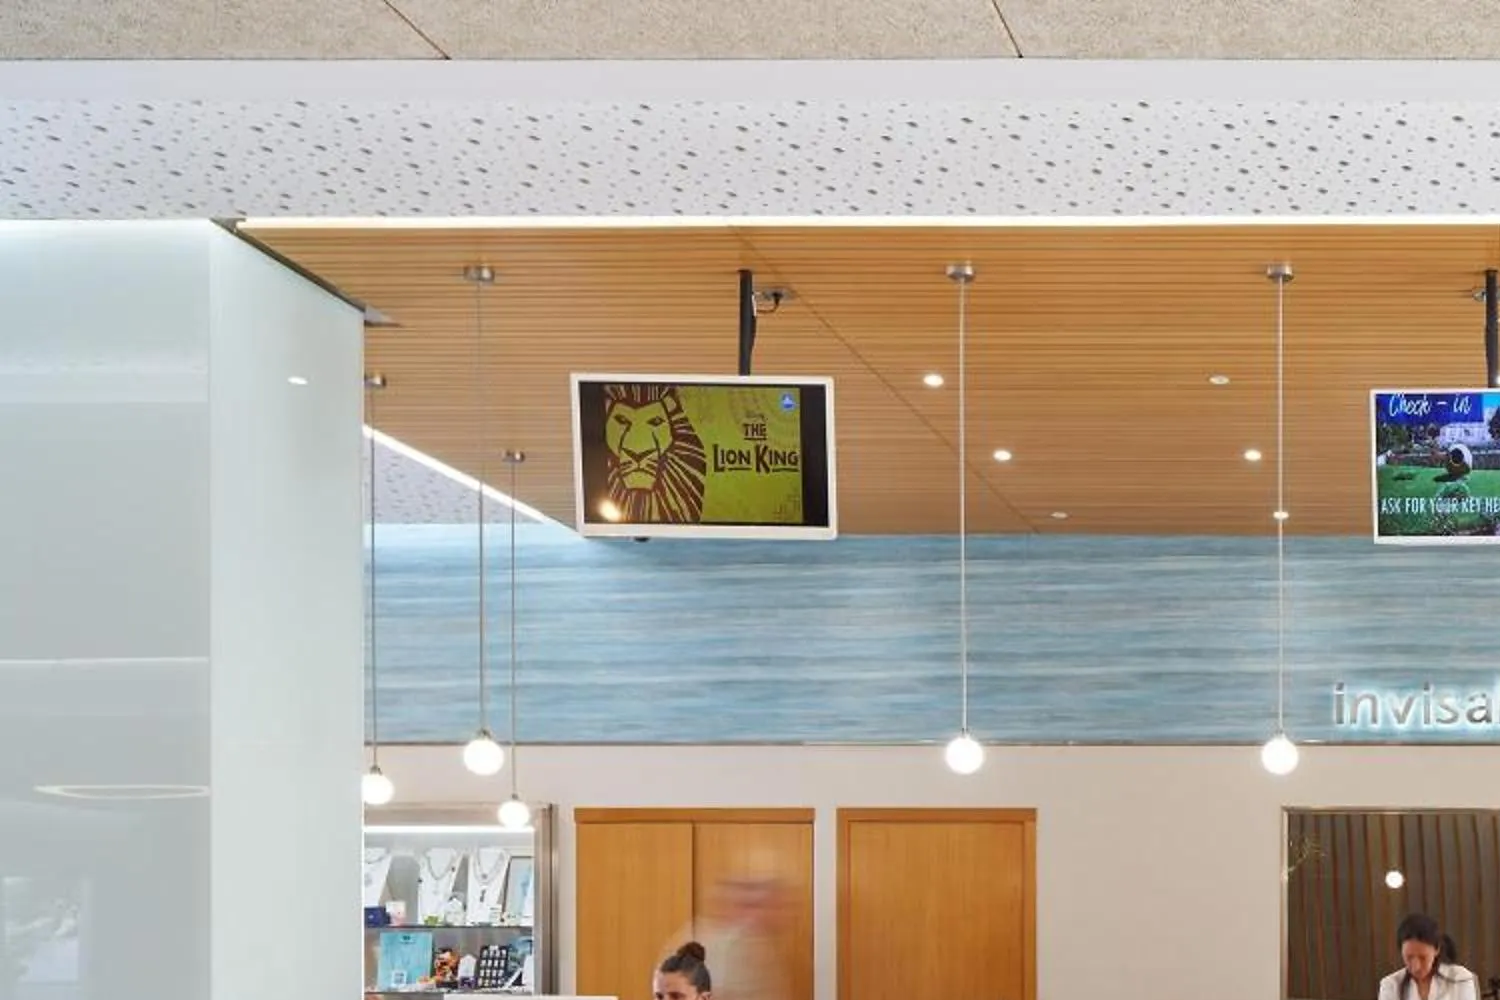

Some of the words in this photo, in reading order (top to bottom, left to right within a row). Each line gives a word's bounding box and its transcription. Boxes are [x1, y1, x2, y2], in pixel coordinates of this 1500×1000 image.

[742, 423, 767, 437] THE
[713, 443, 752, 473] LION
[755, 443, 799, 474] KING
[1381, 497, 1401, 514] ASK
[1405, 497, 1426, 514] FOR
[1429, 497, 1459, 513] YOUR
[1461, 497, 1482, 513] KEY
